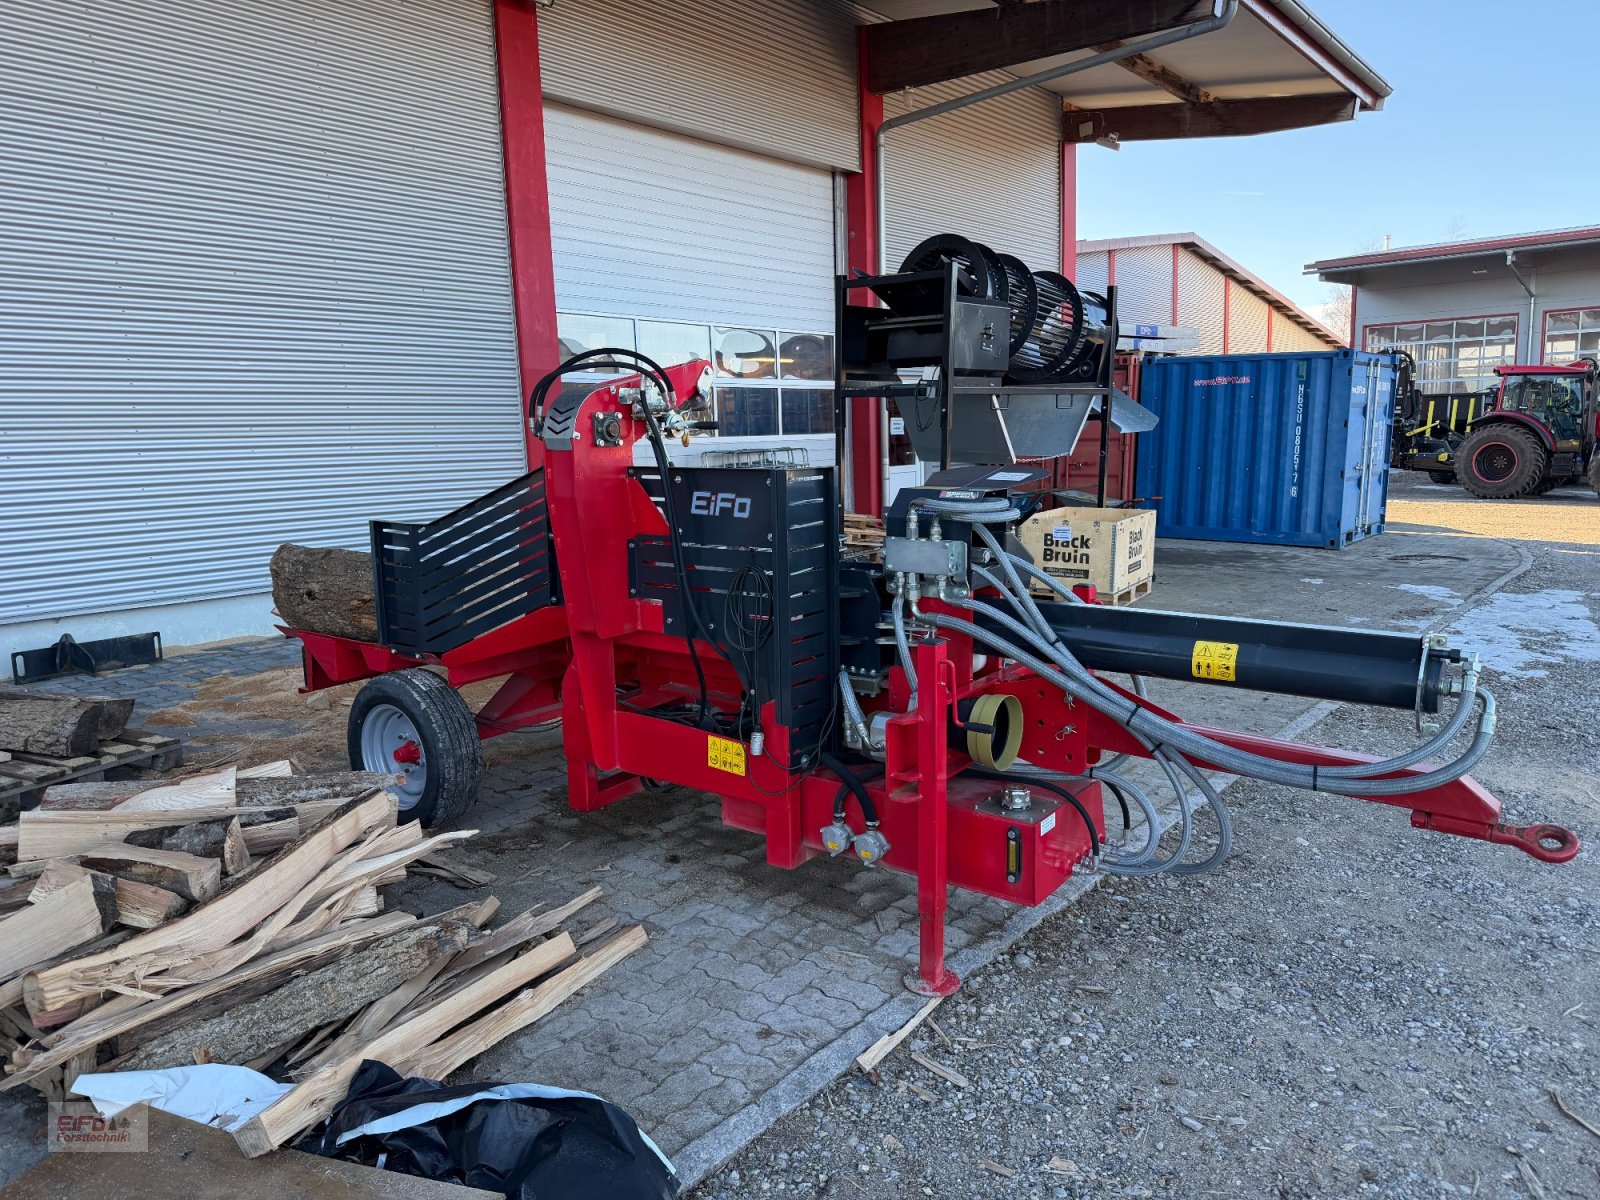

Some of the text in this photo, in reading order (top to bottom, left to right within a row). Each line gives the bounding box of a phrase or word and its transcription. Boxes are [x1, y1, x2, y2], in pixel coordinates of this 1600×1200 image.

[1043, 533, 1091, 549] Black
[1128, 527, 1143, 545] Black
[1042, 548, 1090, 565] Bruin
[1128, 544, 1143, 560] Bruin
